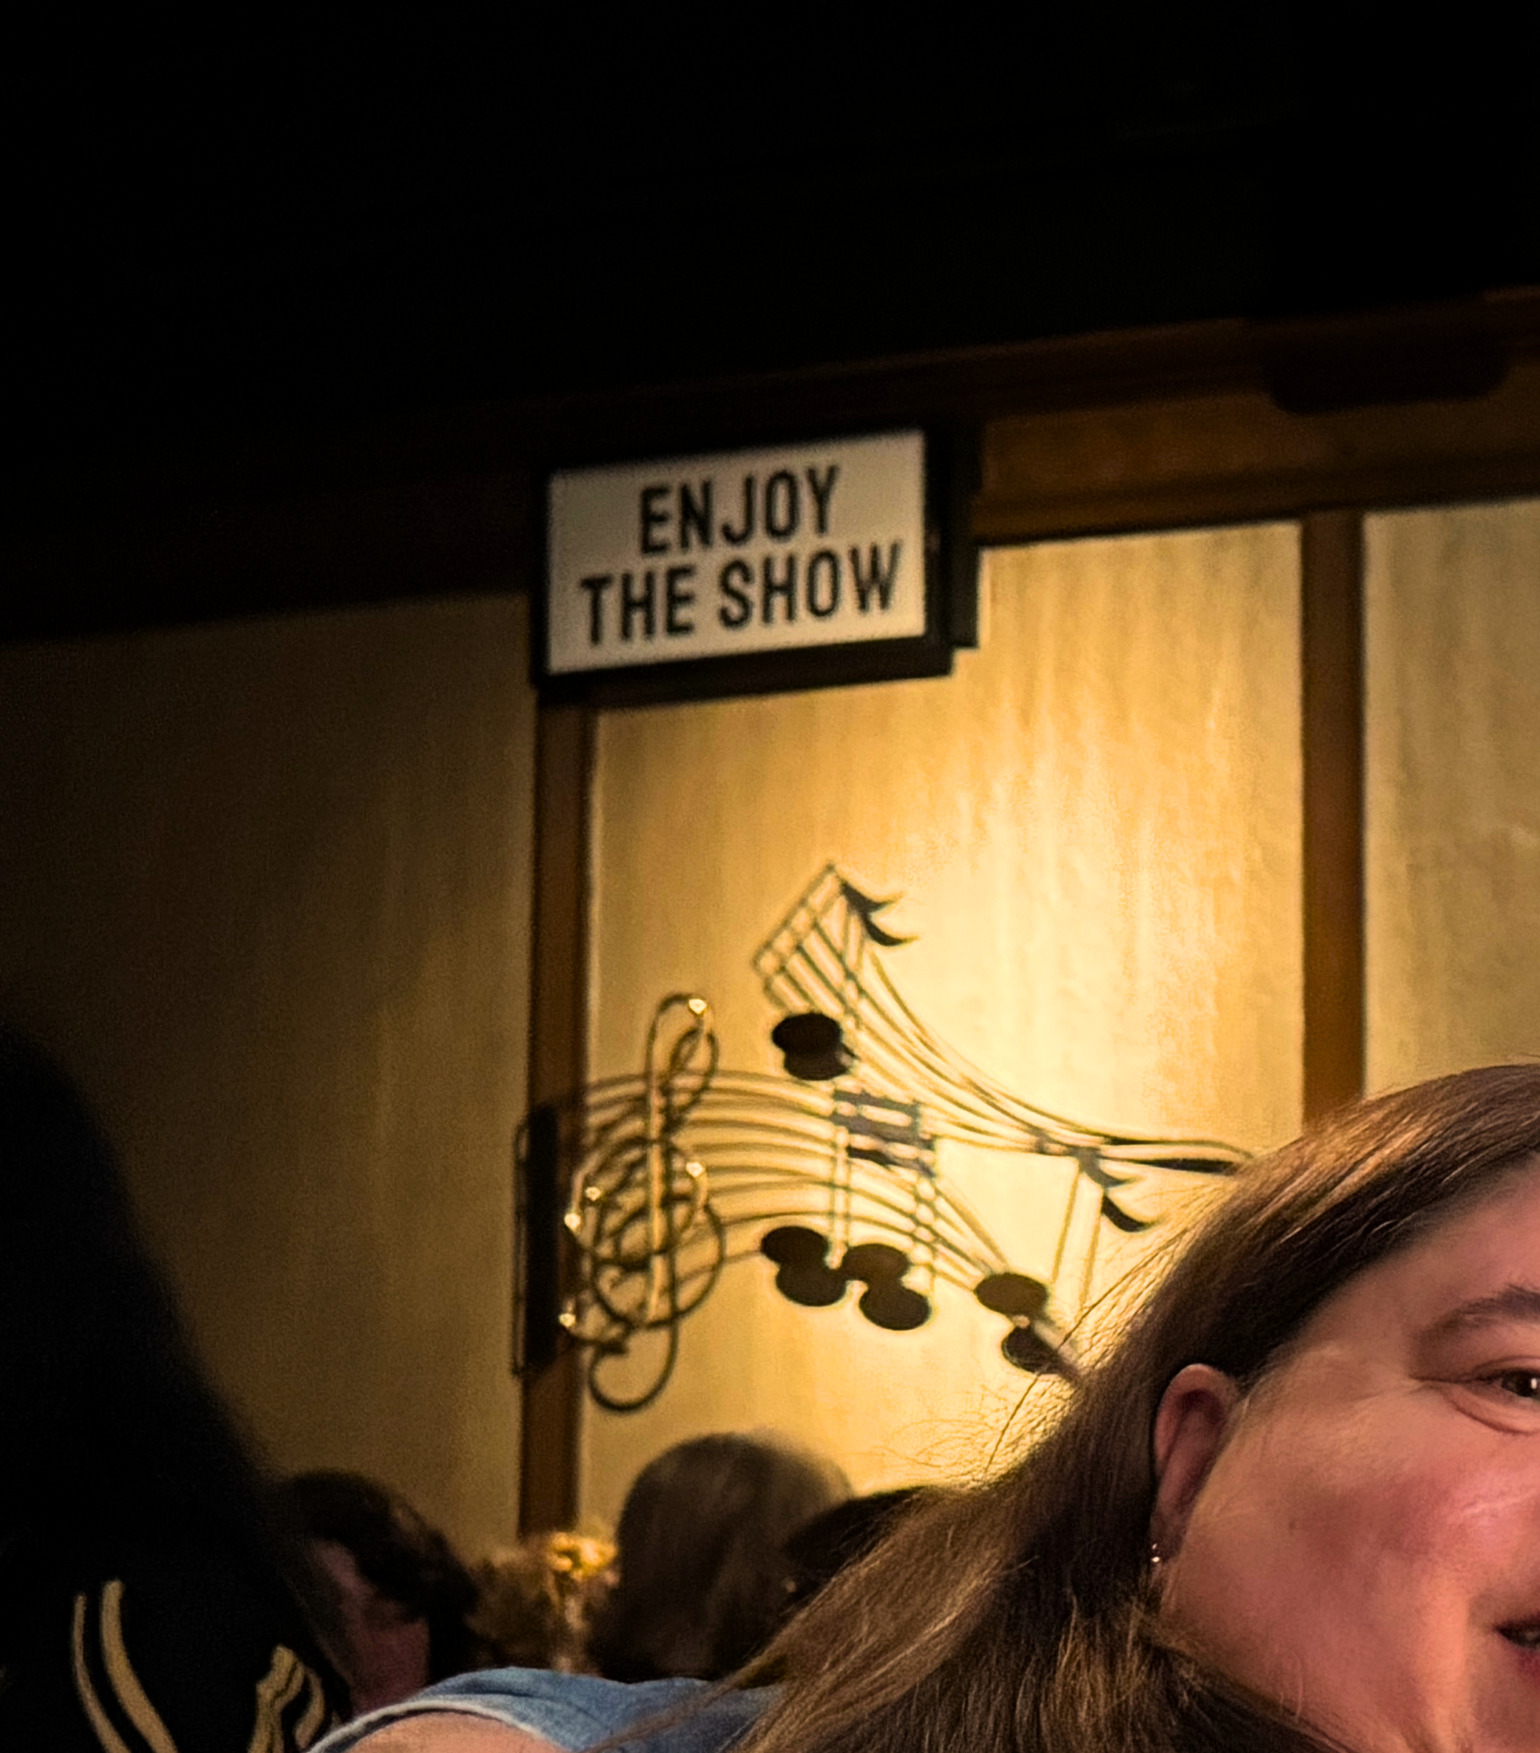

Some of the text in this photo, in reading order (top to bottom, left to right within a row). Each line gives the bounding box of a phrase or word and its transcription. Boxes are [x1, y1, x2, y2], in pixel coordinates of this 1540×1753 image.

[639, 464, 839, 557] ENJOY
[580, 539, 902, 647] THE SHOW
